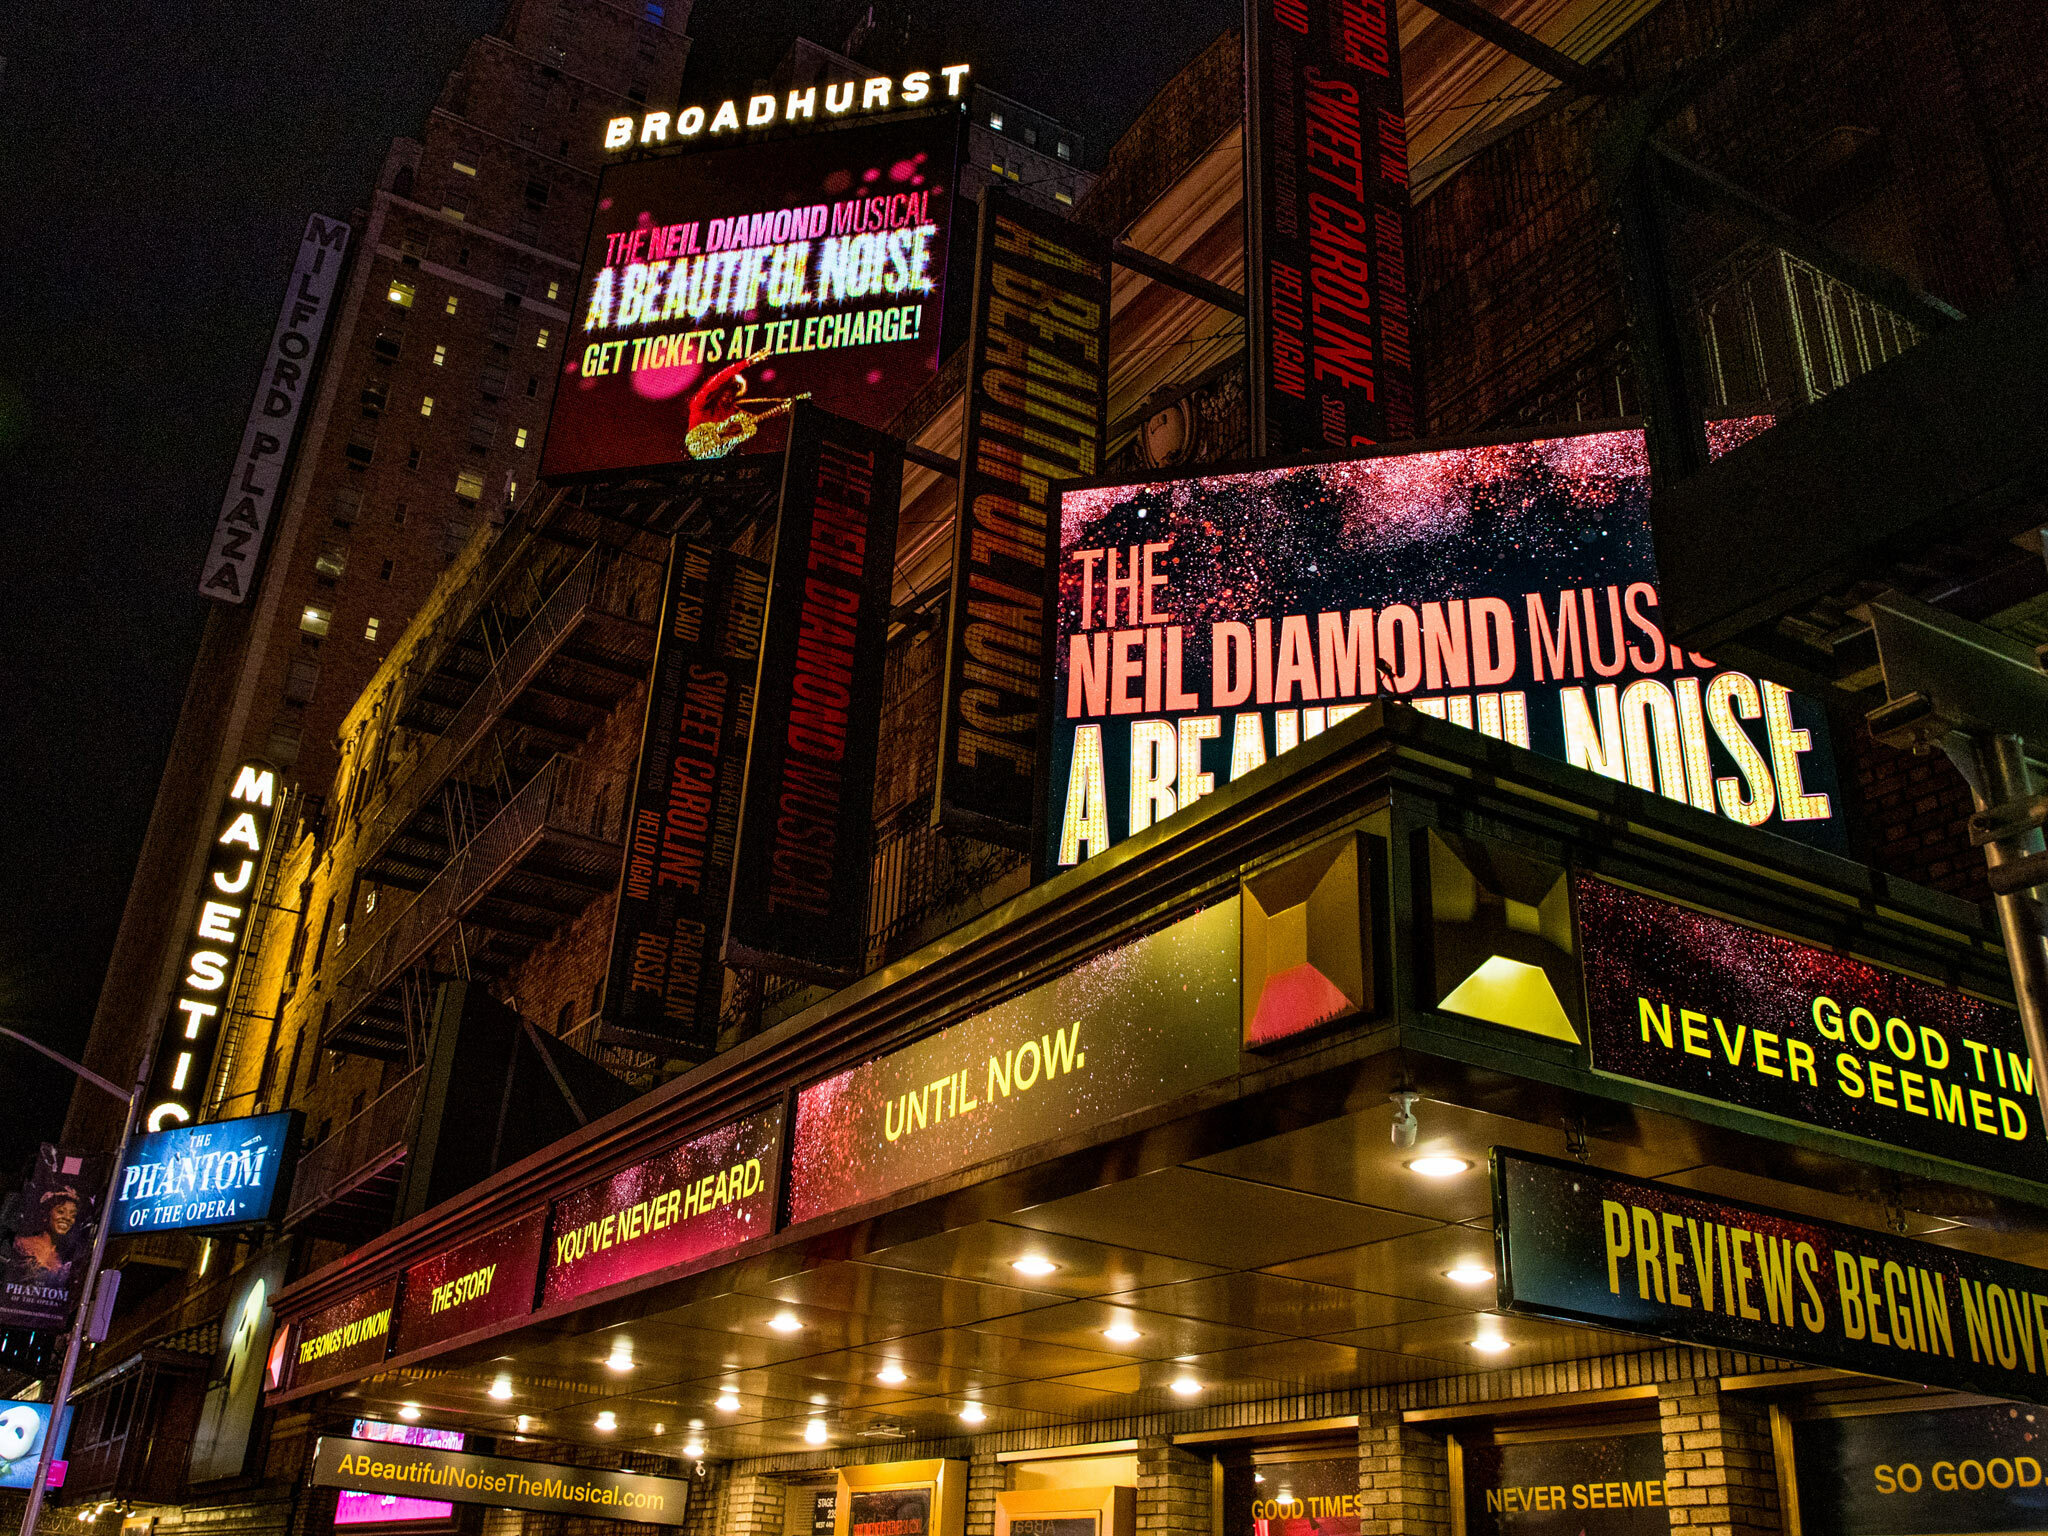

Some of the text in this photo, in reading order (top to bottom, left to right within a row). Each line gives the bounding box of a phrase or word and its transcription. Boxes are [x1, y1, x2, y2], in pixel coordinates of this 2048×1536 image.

[604, 64, 969, 149] BROADHURST
[1302, 65, 1365, 204] SWEET
[1377, 108, 1409, 191] PLAY ME
[606, 190, 933, 267] THE NEIL DIAMOND MUSICAL
[993, 215, 1101, 281] A
[1374, 203, 1406, 295] FOREVER
[584, 224, 937, 332] A BEAUTIFUL NOISE
[1270, 260, 1304, 332] HELLO
[1308, 192, 1376, 403] CAROLINE
[1379, 290, 1408, 319] IN
[581, 304, 923, 378] GET TICKETS AT TELECHARGE!
[1271, 325, 1306, 401] AGAIN
[1380, 315, 1412, 373] BLUE
[205, 216, 349, 597] MILFORD PLAZA
[970, 260, 1100, 570] BEAUTIFUL
[673, 600, 703, 643] SAID
[723, 563, 768, 662] AMERICA
[1073, 541, 1173, 630] THE
[767, 440, 876, 916] THE NEIL DIAMOND MUSICAL
[1066, 619, 1198, 718] NEIL
[1213, 597, 1516, 709] DIAMOND
[678, 663, 728, 757] SWEET
[1058, 723, 1109, 866] A
[1559, 670, 1833, 827] NOISE
[632, 809, 662, 856] HELLO
[657, 756, 716, 896] CAROLINE
[626, 854, 655, 902] AGAIN
[147, 765, 274, 1132] MAJESTIC
[630, 932, 670, 999] ROSIE
[1638, 996, 2028, 1142] NEVER SEEMED
[1811, 996, 1950, 1070] GOOD
[884, 1021, 1085, 1142] UNTIL NOW.
[119, 1145, 269, 1201] PHANTOM
[190, 1133, 213, 1148] THE
[129, 1198, 236, 1227] OF THE OPERA
[556, 1158, 765, 1267] YOU'VE NEVER HEARD.
[5, 1282, 69, 1302] PHANTOM
[431, 1263, 497, 1315] THE STORY
[1602, 1199, 1826, 1334] PREVIEWS
[1834, 1249, 1956, 1359] BEGIN
[298, 1340, 318, 1365] THE
[313, 1328, 343, 1359] SONGS
[342, 1319, 363, 1350] YOU
[337, 1453, 665, 1512] ABeautifulNoiseTheMusical.com
[817, 1498, 835, 1508] STAGE
[1252, 1494, 1363, 1522] GOOD TIMES
[1485, 1485, 1567, 1514] NEVER
[1873, 1463, 1923, 1495] SO
